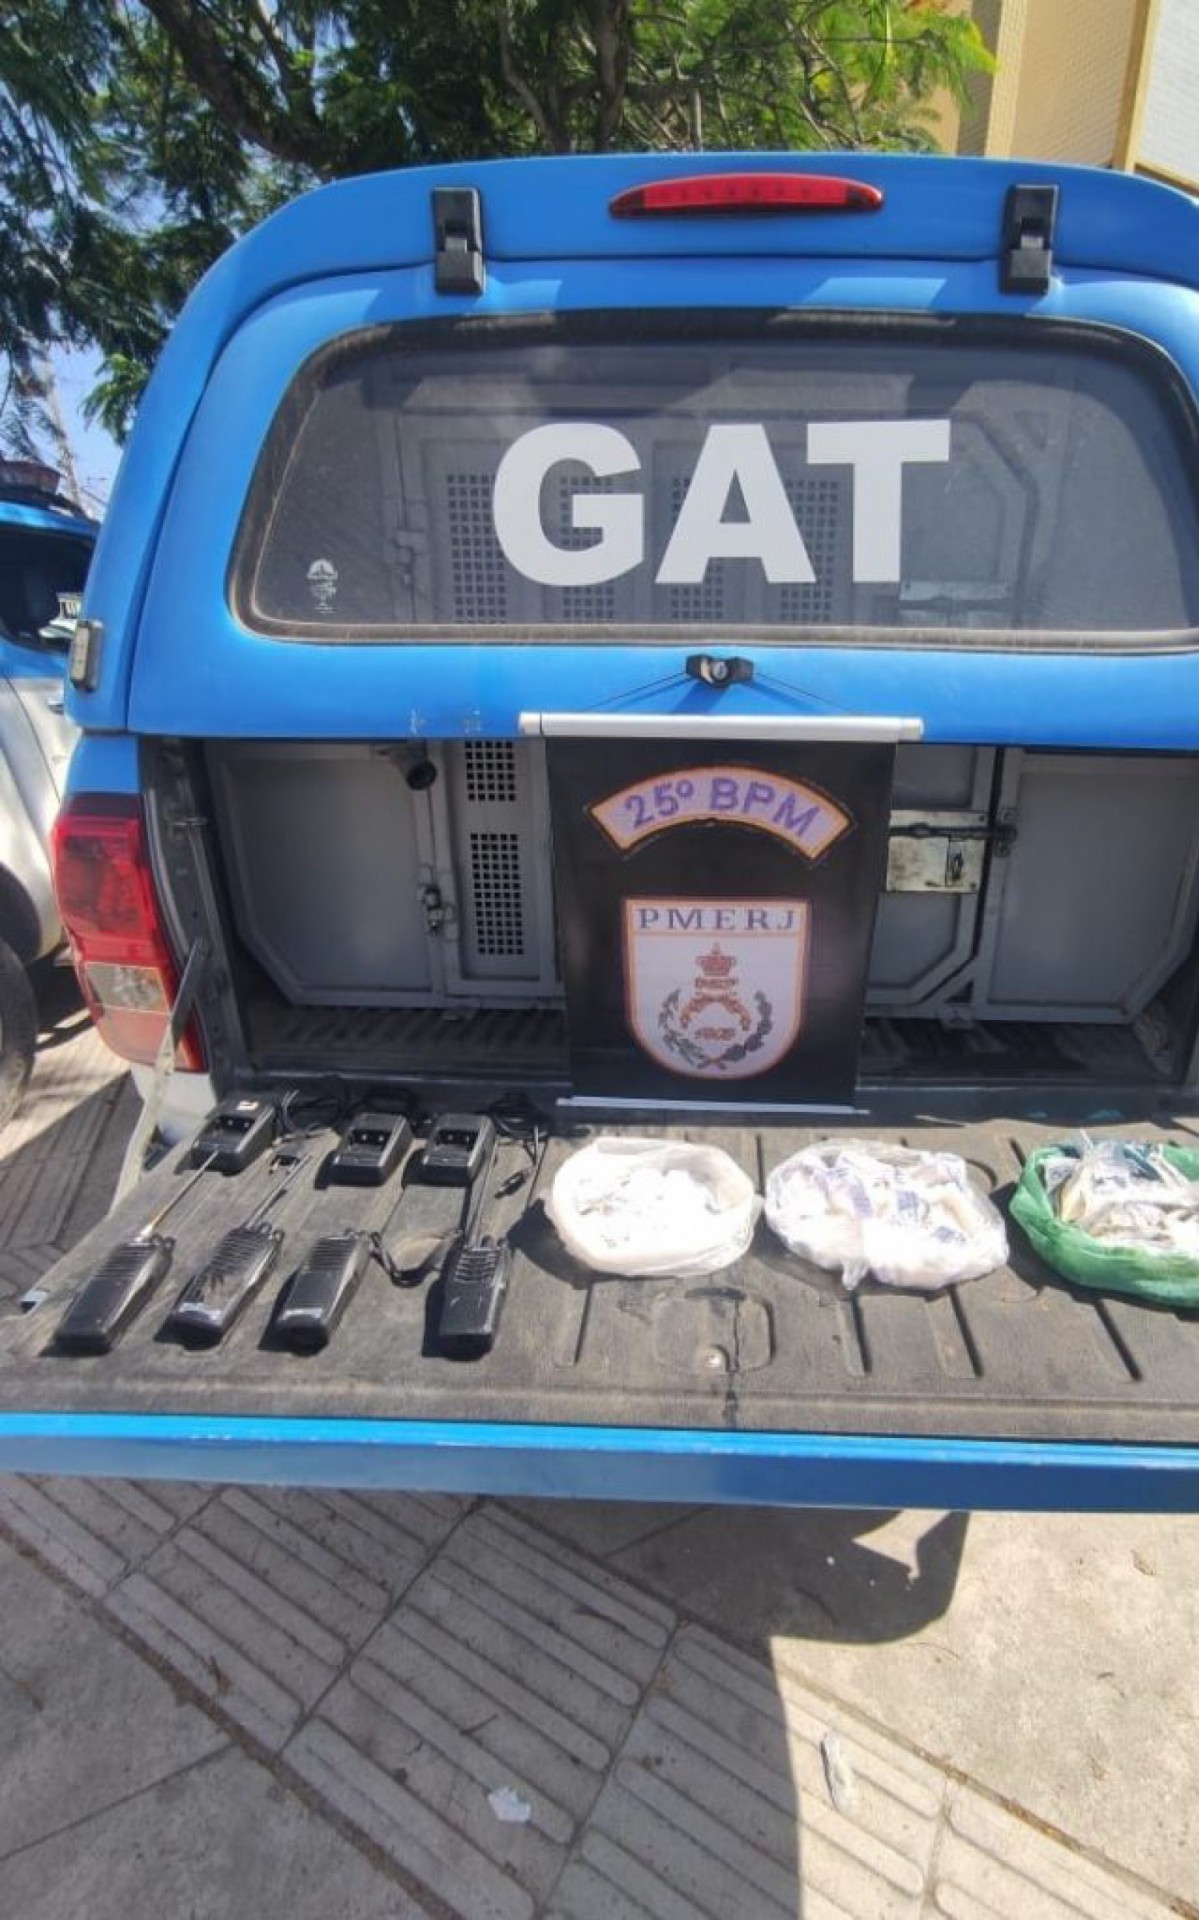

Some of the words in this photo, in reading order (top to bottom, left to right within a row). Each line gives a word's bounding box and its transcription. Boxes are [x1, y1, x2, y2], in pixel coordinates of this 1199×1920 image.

[493, 420, 951, 586] GAT
[709, 777, 820, 836] BPM
[638, 908, 795, 930] PMERJ
